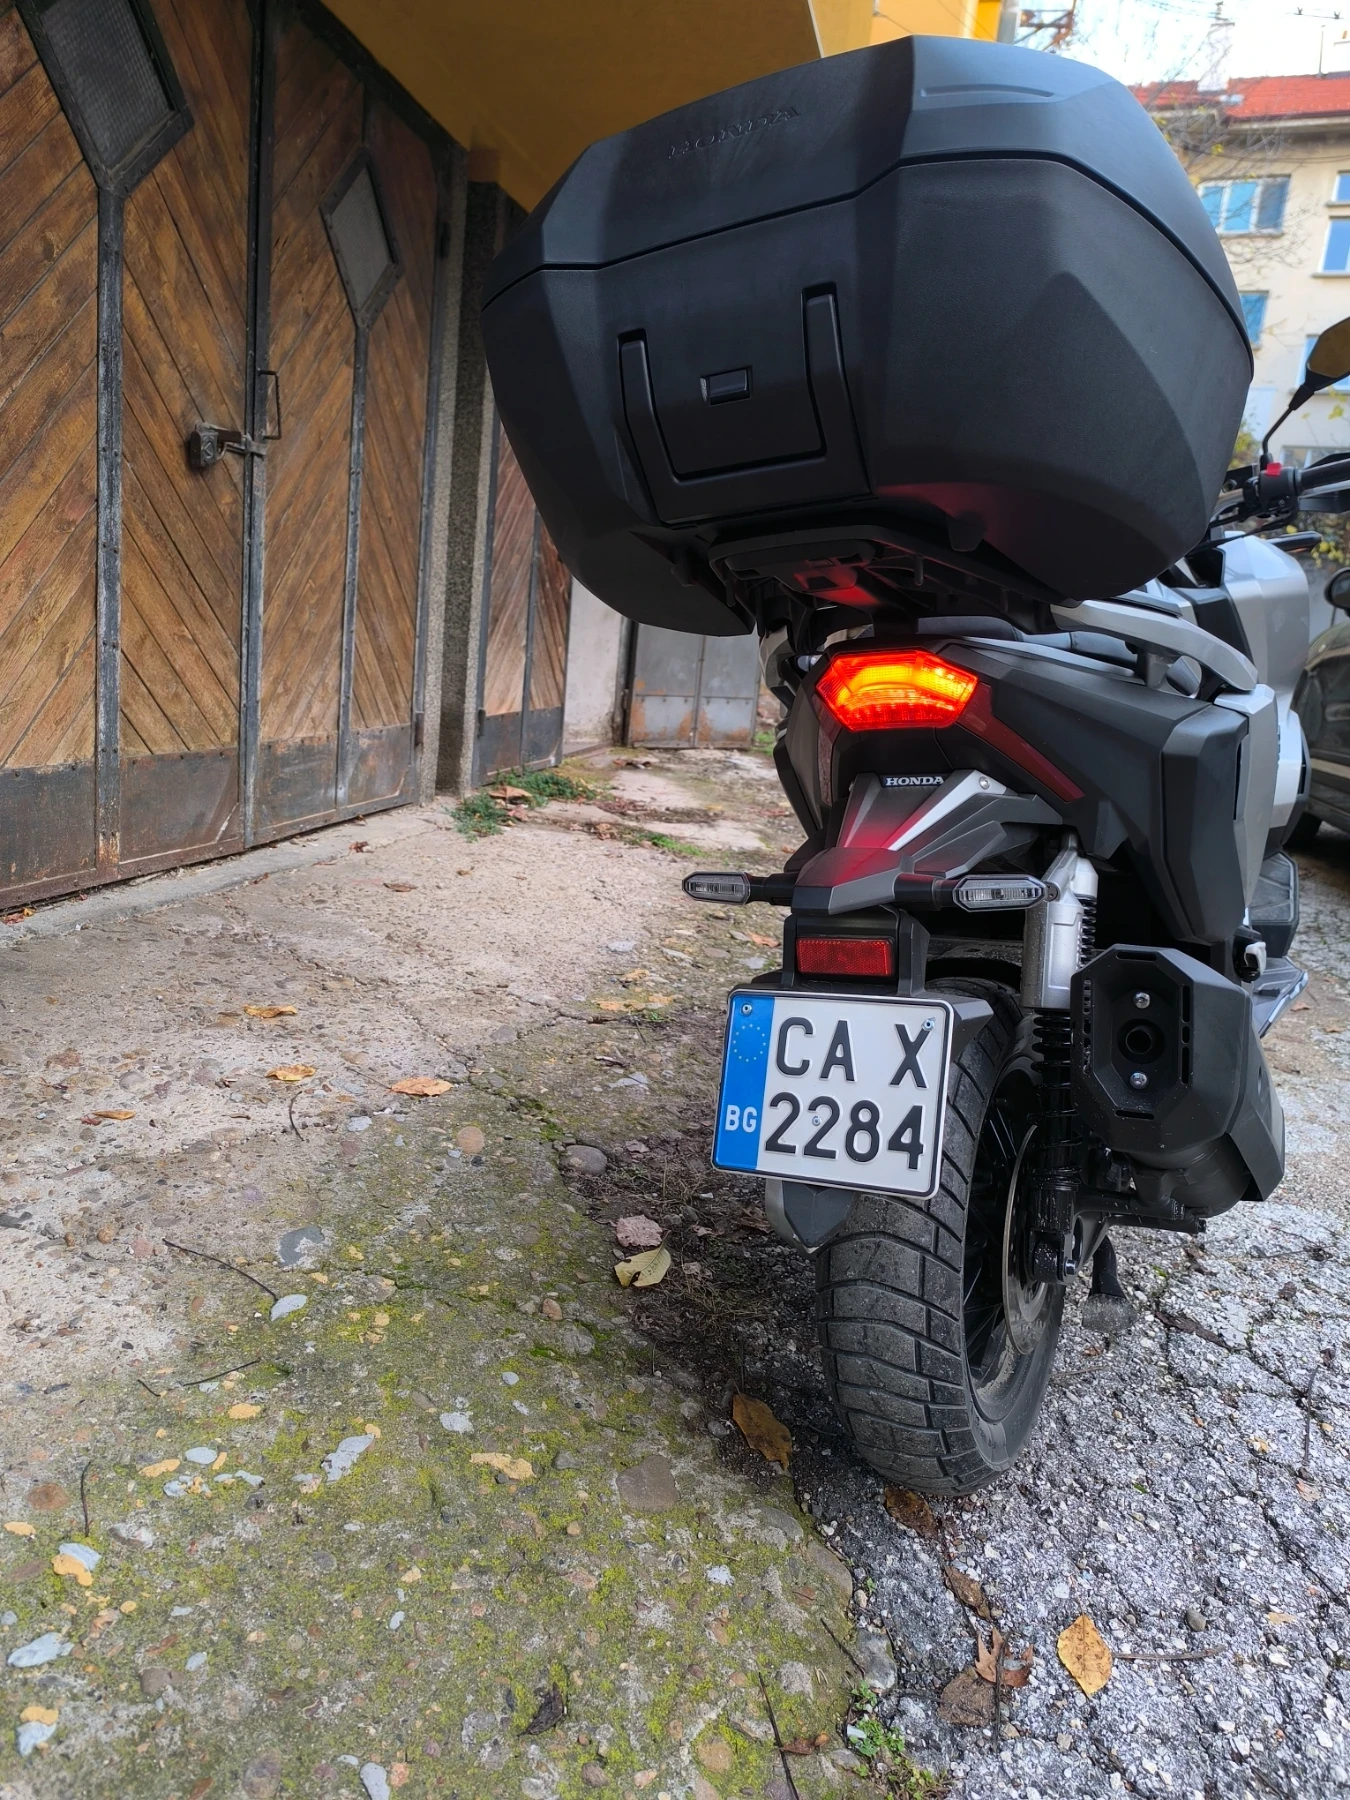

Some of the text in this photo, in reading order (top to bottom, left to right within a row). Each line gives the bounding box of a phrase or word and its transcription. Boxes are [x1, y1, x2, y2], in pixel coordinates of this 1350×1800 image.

[885, 776, 945, 786] HONDA
[776, 1016, 935, 1089] CA X
[724, 1104, 758, 1133] BG
[765, 1091, 925, 1170] 2284
